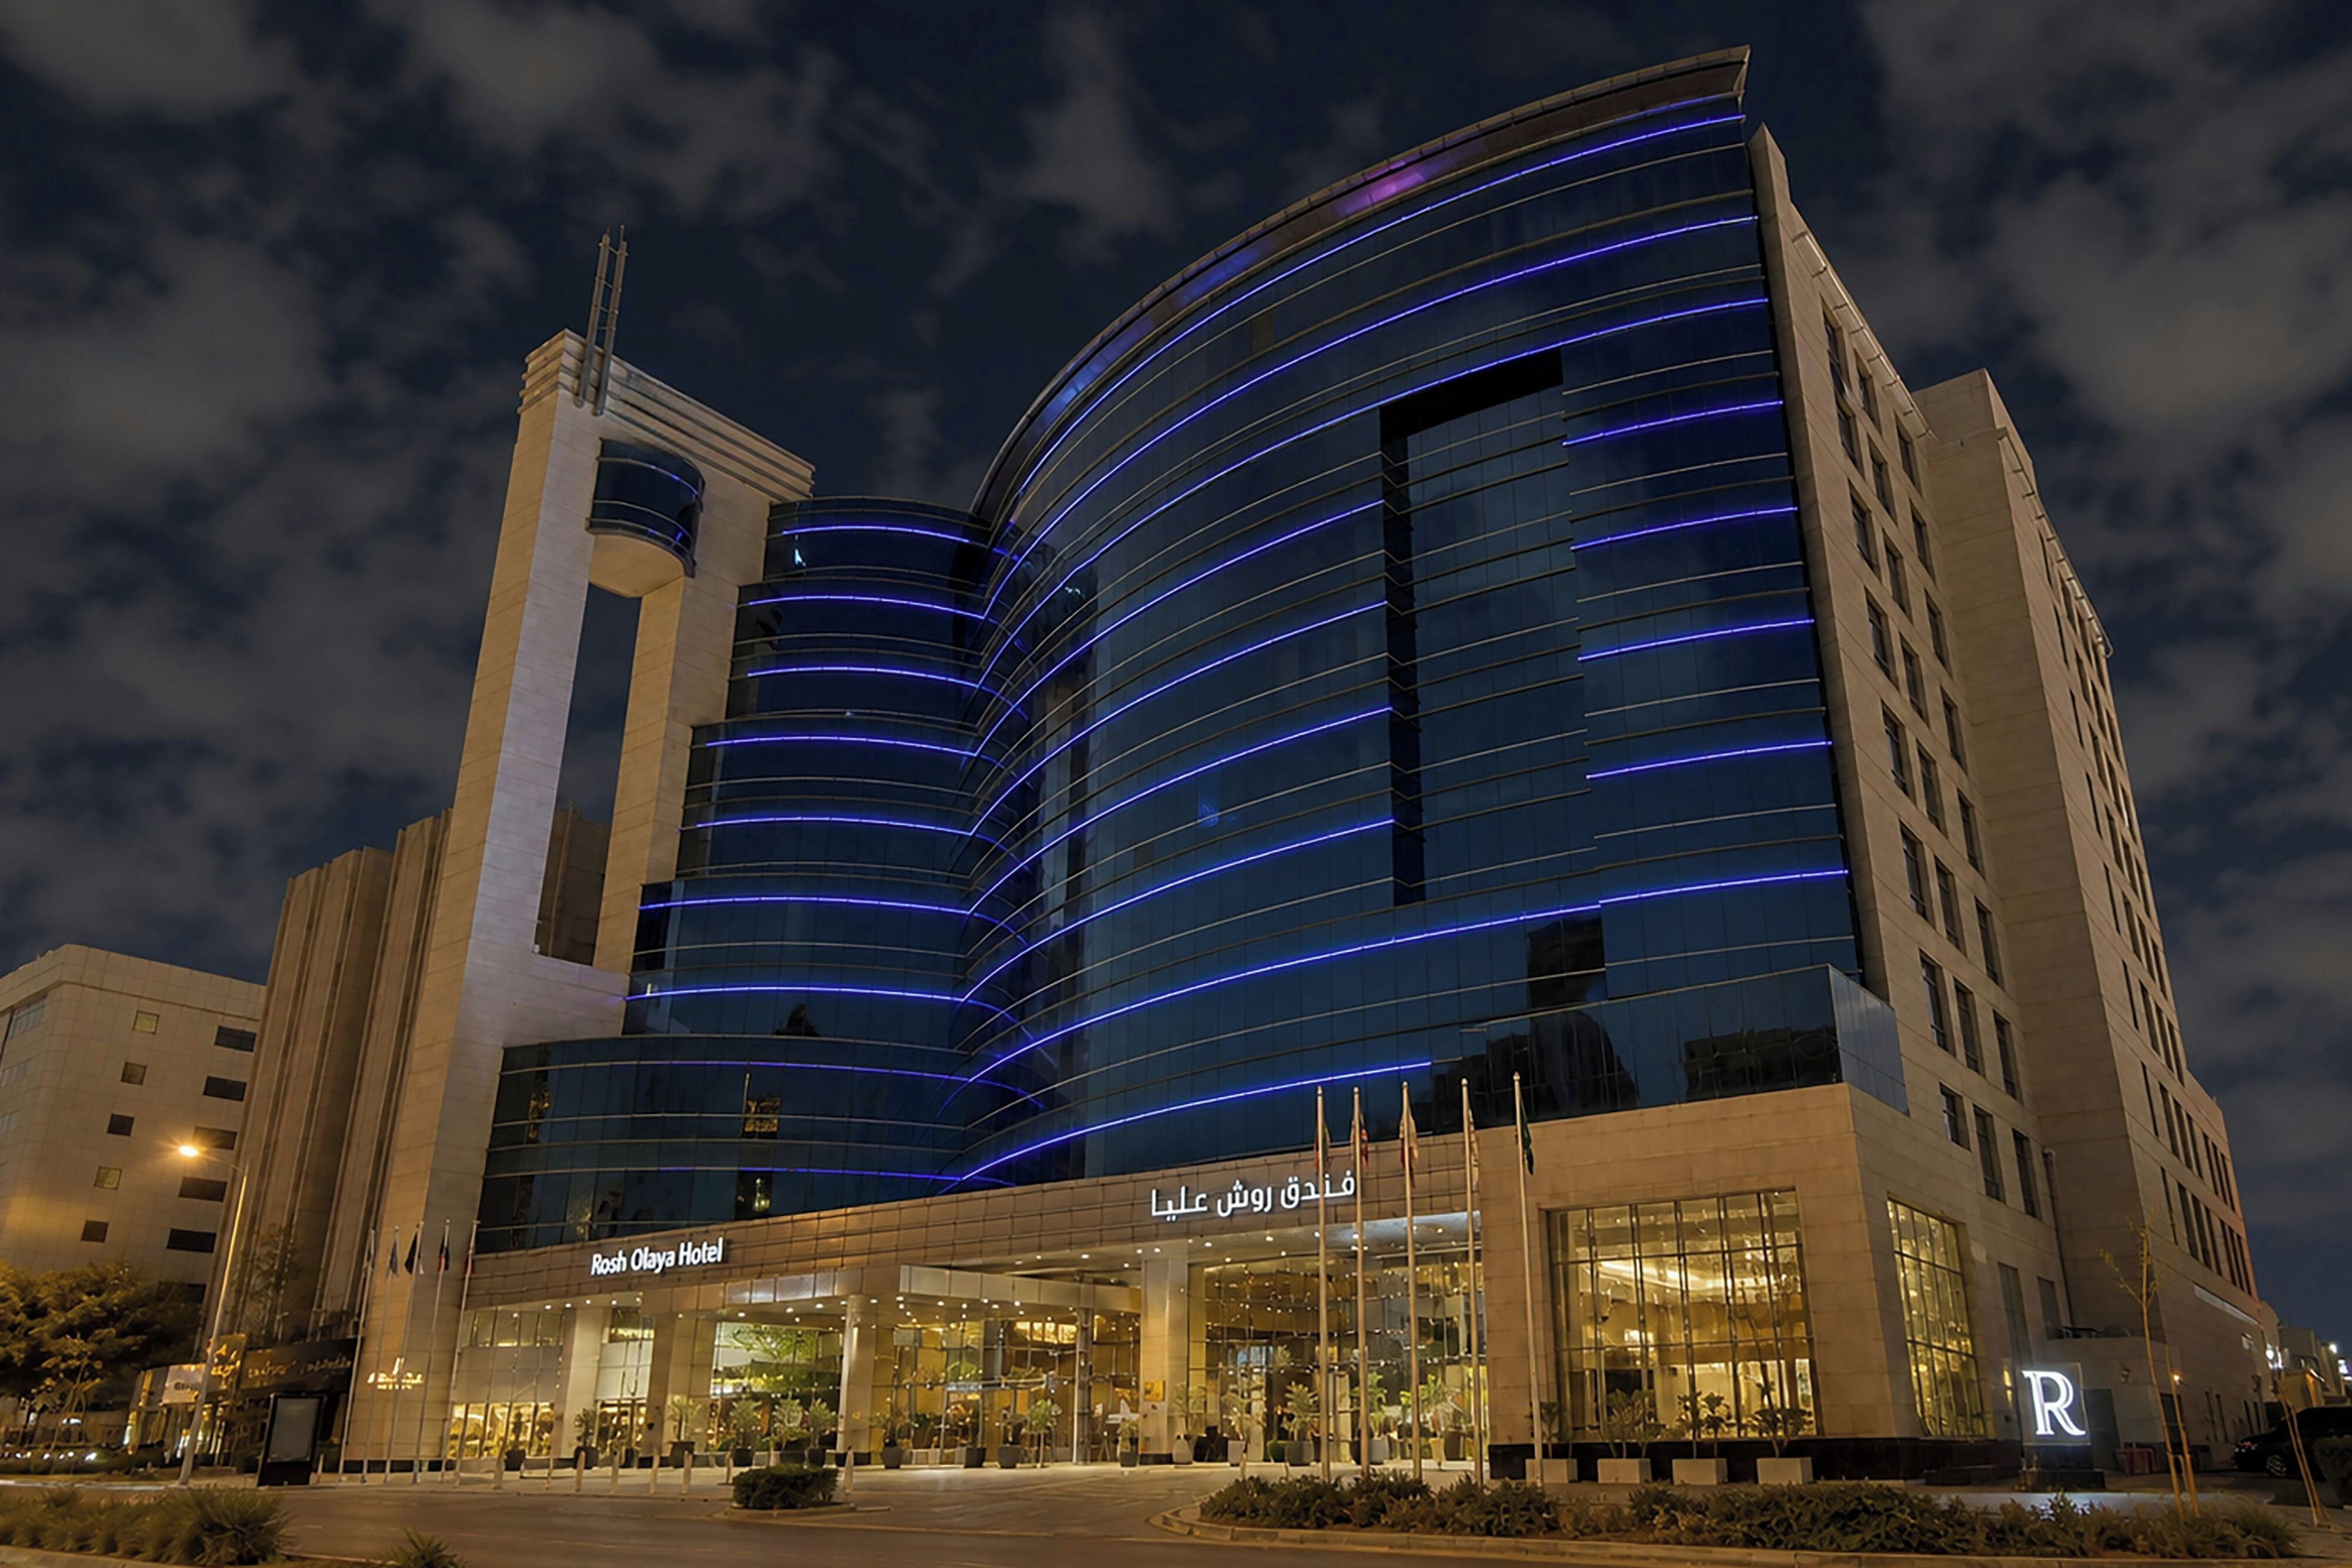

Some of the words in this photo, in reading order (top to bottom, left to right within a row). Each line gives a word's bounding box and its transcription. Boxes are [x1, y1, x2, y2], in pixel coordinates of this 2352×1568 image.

[1151, 1185, 1208, 1221] عليا
[1217, 1179, 1272, 1217] روش
[1280, 1170, 1355, 1209] فندق
[590, 1250, 627, 1276] Rosh
[630, 1246, 676, 1274] Olaya
[678, 1236, 724, 1266] Hotel
[2021, 1370, 2086, 1436] R
